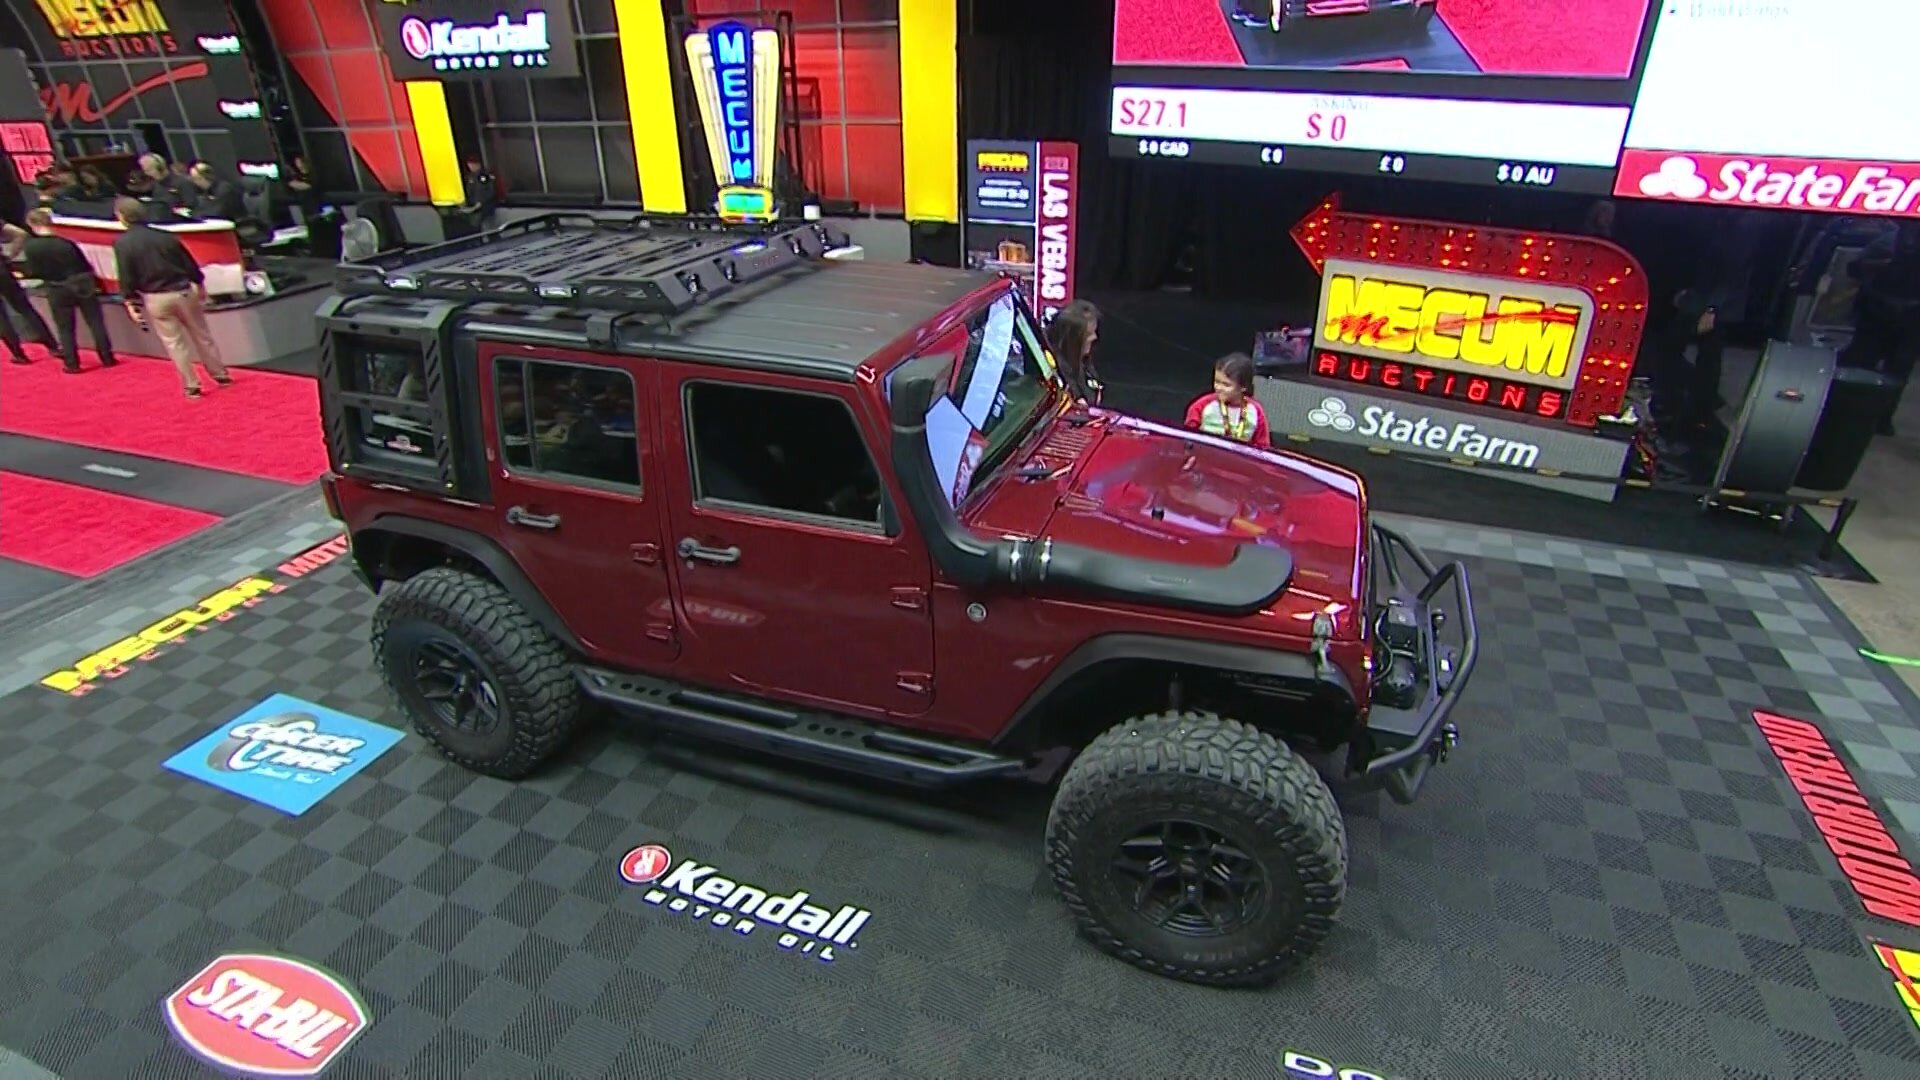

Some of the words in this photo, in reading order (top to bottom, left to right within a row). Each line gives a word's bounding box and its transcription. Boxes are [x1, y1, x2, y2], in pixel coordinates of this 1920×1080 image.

[430, 12, 549, 55] Kendall
[435, 55, 499, 70] MOTOR
[513, 54, 547, 66] OIL
[717, 31, 752, 180] MECUM
[1120, 98, 1187, 128] S27.1
[1043, 172, 1069, 218] LAS
[1322, 276, 1583, 378] MECUM
[1317, 354, 1564, 418] AUCTIONS
[643, 889, 756, 935] MOTOR
[778, 933, 834, 961] OIL
[660, 859, 872, 945] Kendall
